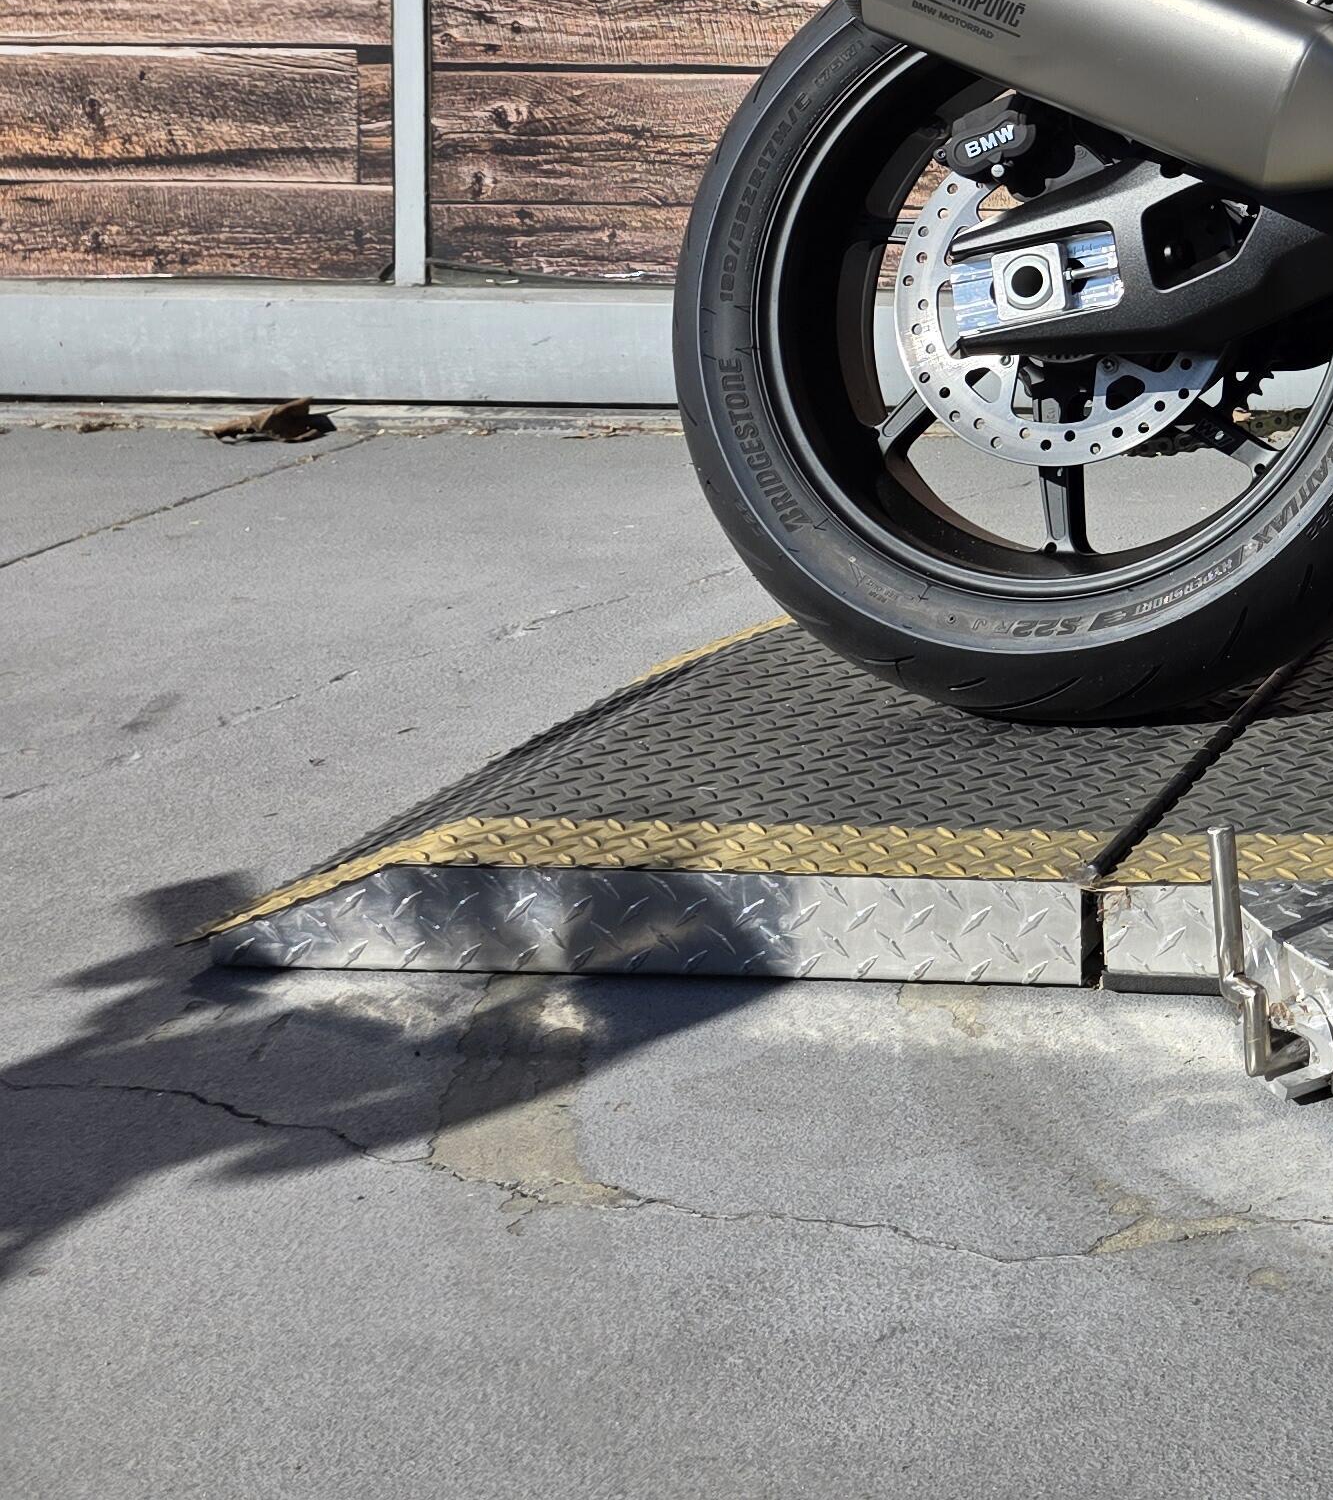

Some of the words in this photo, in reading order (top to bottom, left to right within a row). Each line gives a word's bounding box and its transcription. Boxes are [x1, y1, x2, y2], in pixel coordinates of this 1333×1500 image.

[911, 0, 937, 16] BMW
[938, 9, 994, 40] MOTORRAD
[964, 123, 1016, 159] BMW
[718, 357, 812, 533] BRIDGESTONE
[1134, 558, 1234, 614] HYPERSPORT
